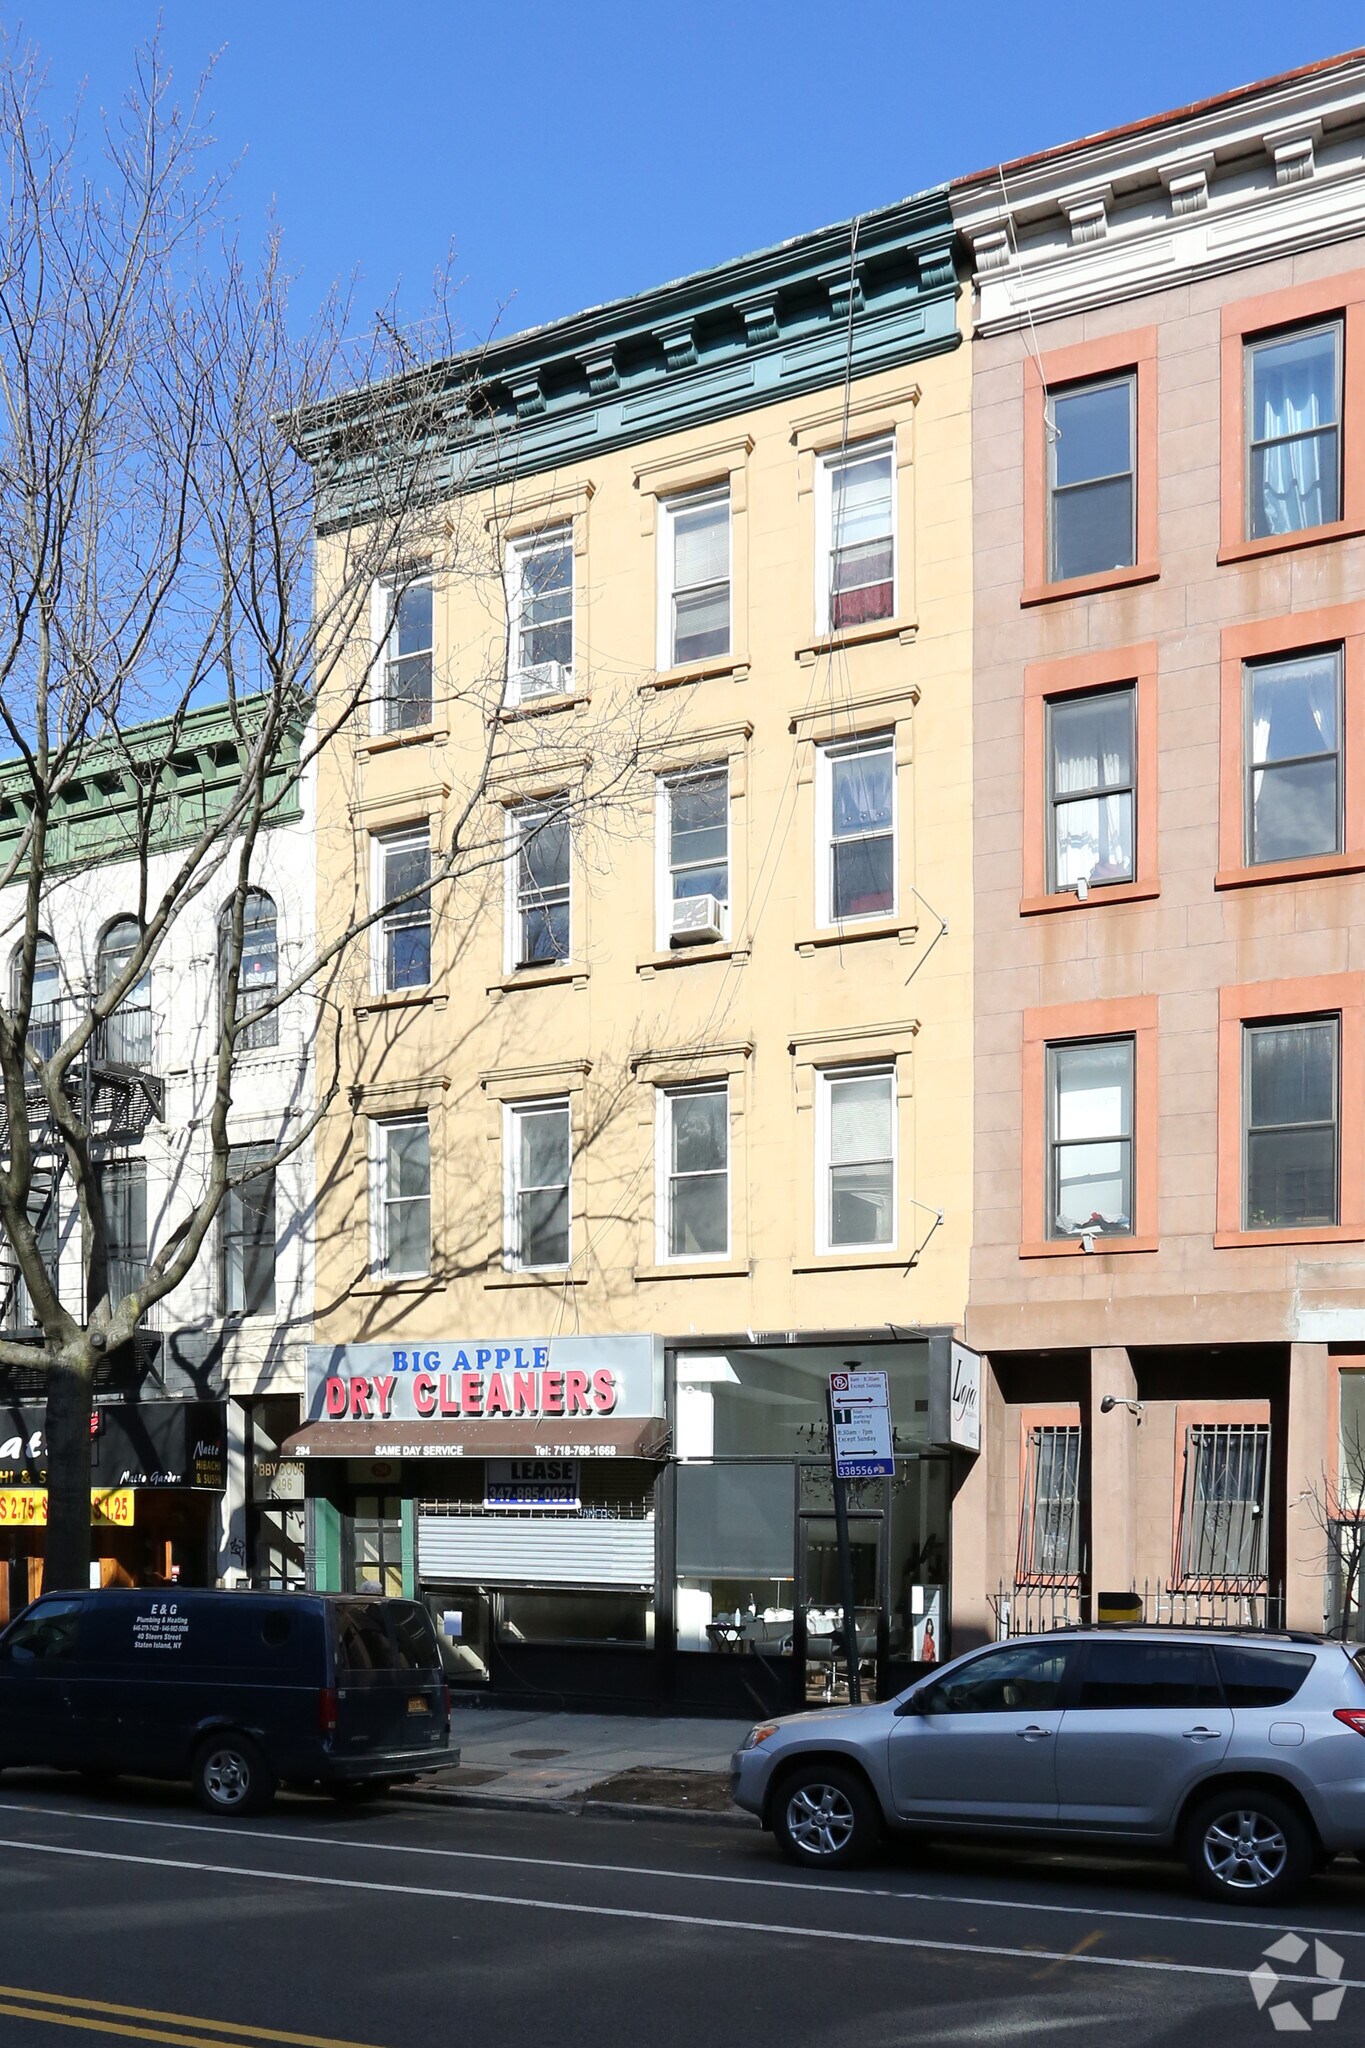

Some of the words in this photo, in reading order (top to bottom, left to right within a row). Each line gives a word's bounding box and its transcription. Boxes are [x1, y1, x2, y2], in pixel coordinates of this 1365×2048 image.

[392, 1350, 441, 1372] BIG
[452, 1346, 549, 1371] APPLE
[326, 1374, 396, 1417] DRY
[412, 1368, 616, 1416] CLEANERS
[839, 1409, 846, 1423] 1
[295, 1446, 310, 1456] 294
[374, 1445, 402, 1456] SAME
[402, 1445, 422, 1456] DAY
[422, 1445, 463, 1456] SERVICE
[534, 1445, 551, 1456] Tel:
[553, 1445, 616, 1456] 718-768-1668
[511, 1461, 573, 1480] LEASE
[839, 1466, 873, 1476] 338556
[119, 1470, 147, 1485] Natto
[150, 1470, 182, 1484] Garden
[489, 1486, 574, 1502] 347-885-0021
[151, 1604, 158, 1614] E
[159, 1604, 167, 1614] &
[169, 1604, 177, 1614] G
[136, 1616, 161, 1624] Plumbing
[166, 1617, 188, 1625] Heating
[164, 1633, 182, 1641] Street
[153, 1642, 172, 1650] Island,
